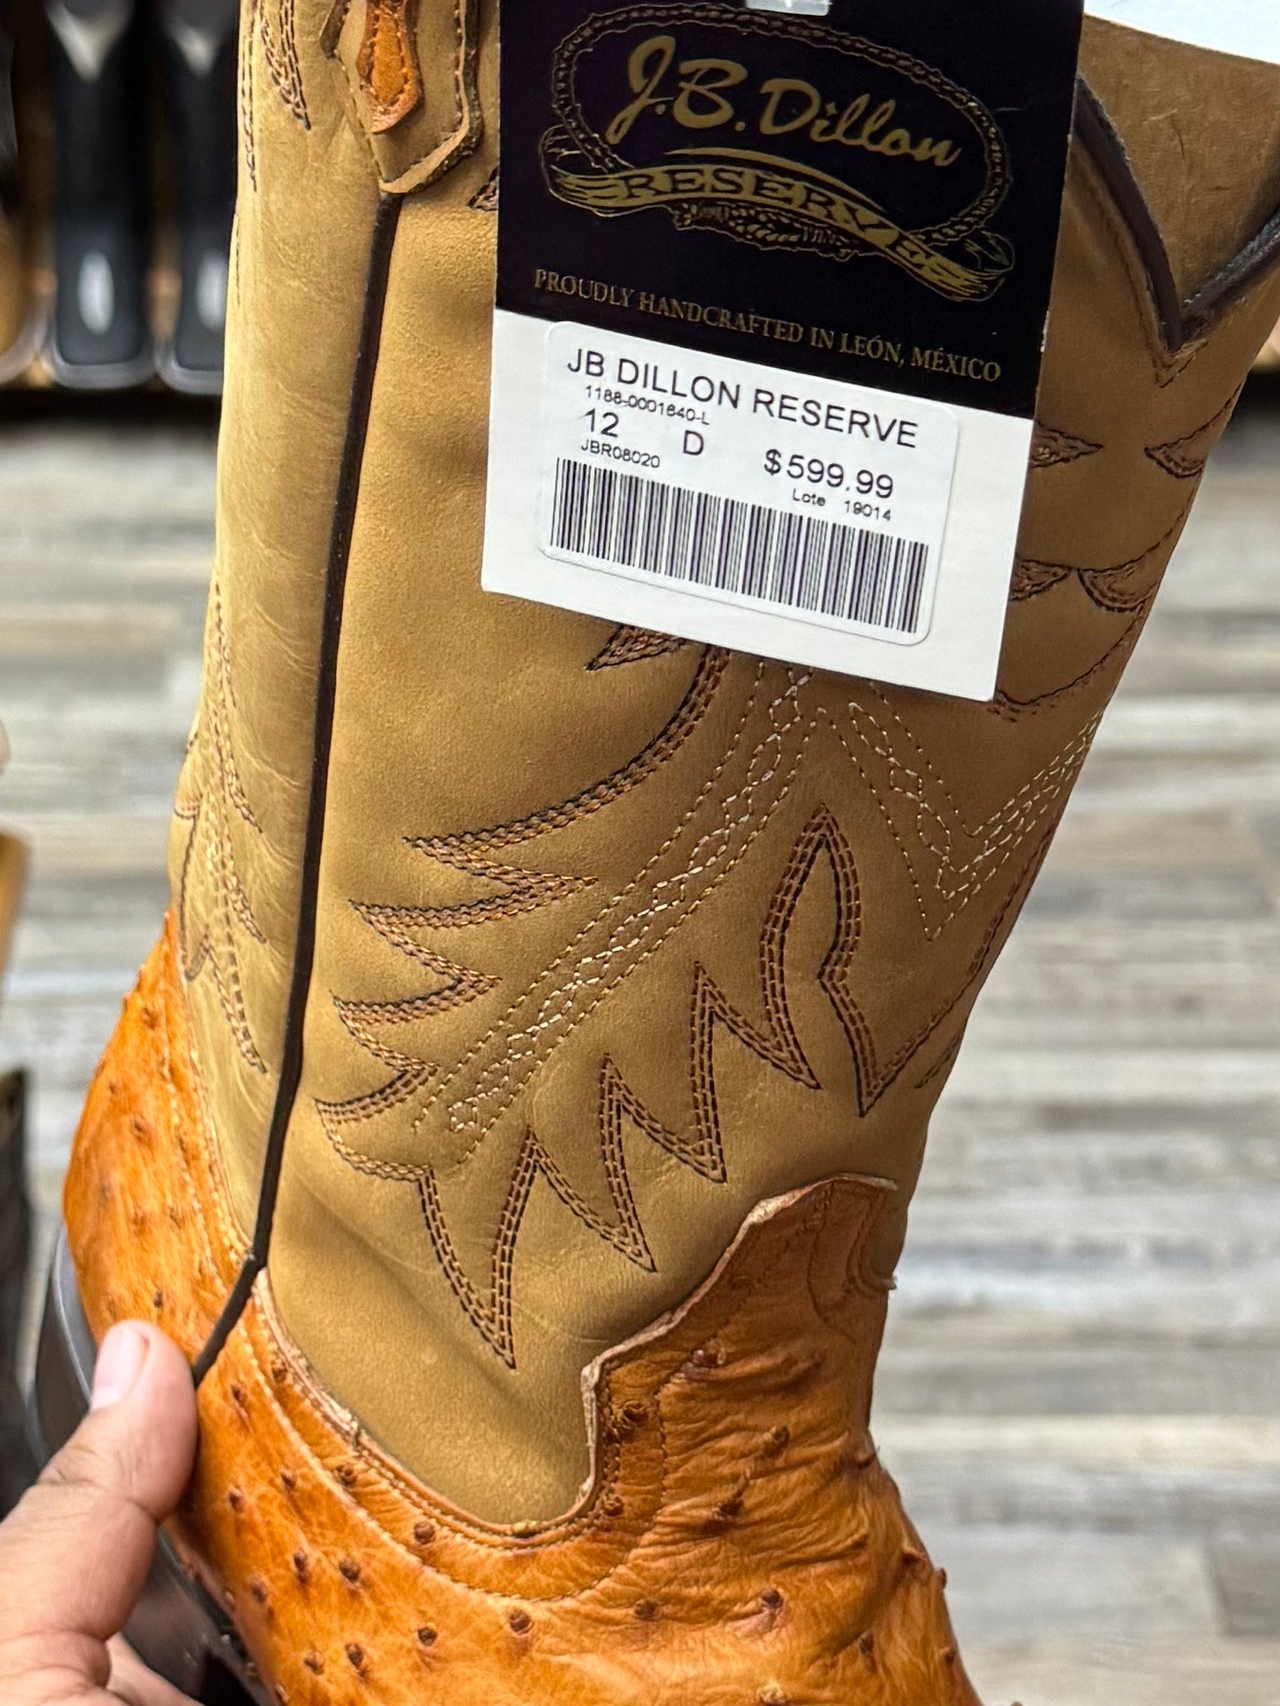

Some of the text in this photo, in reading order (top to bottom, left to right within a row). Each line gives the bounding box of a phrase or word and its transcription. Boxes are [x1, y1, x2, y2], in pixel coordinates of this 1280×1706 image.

[758, 78, 962, 167] Dillon
[622, 166, 934, 271] RESERVE
[534, 268, 1002, 383] PROUDLY HANDCRAFTED IN LEÓN, MÉXICO
[567, 348, 919, 449] JB DILLON RESERVE
[580, 439, 661, 469] JBR08020
[584, 407, 894, 499] 12 D $599.99
[792, 488, 826, 507] Lote
